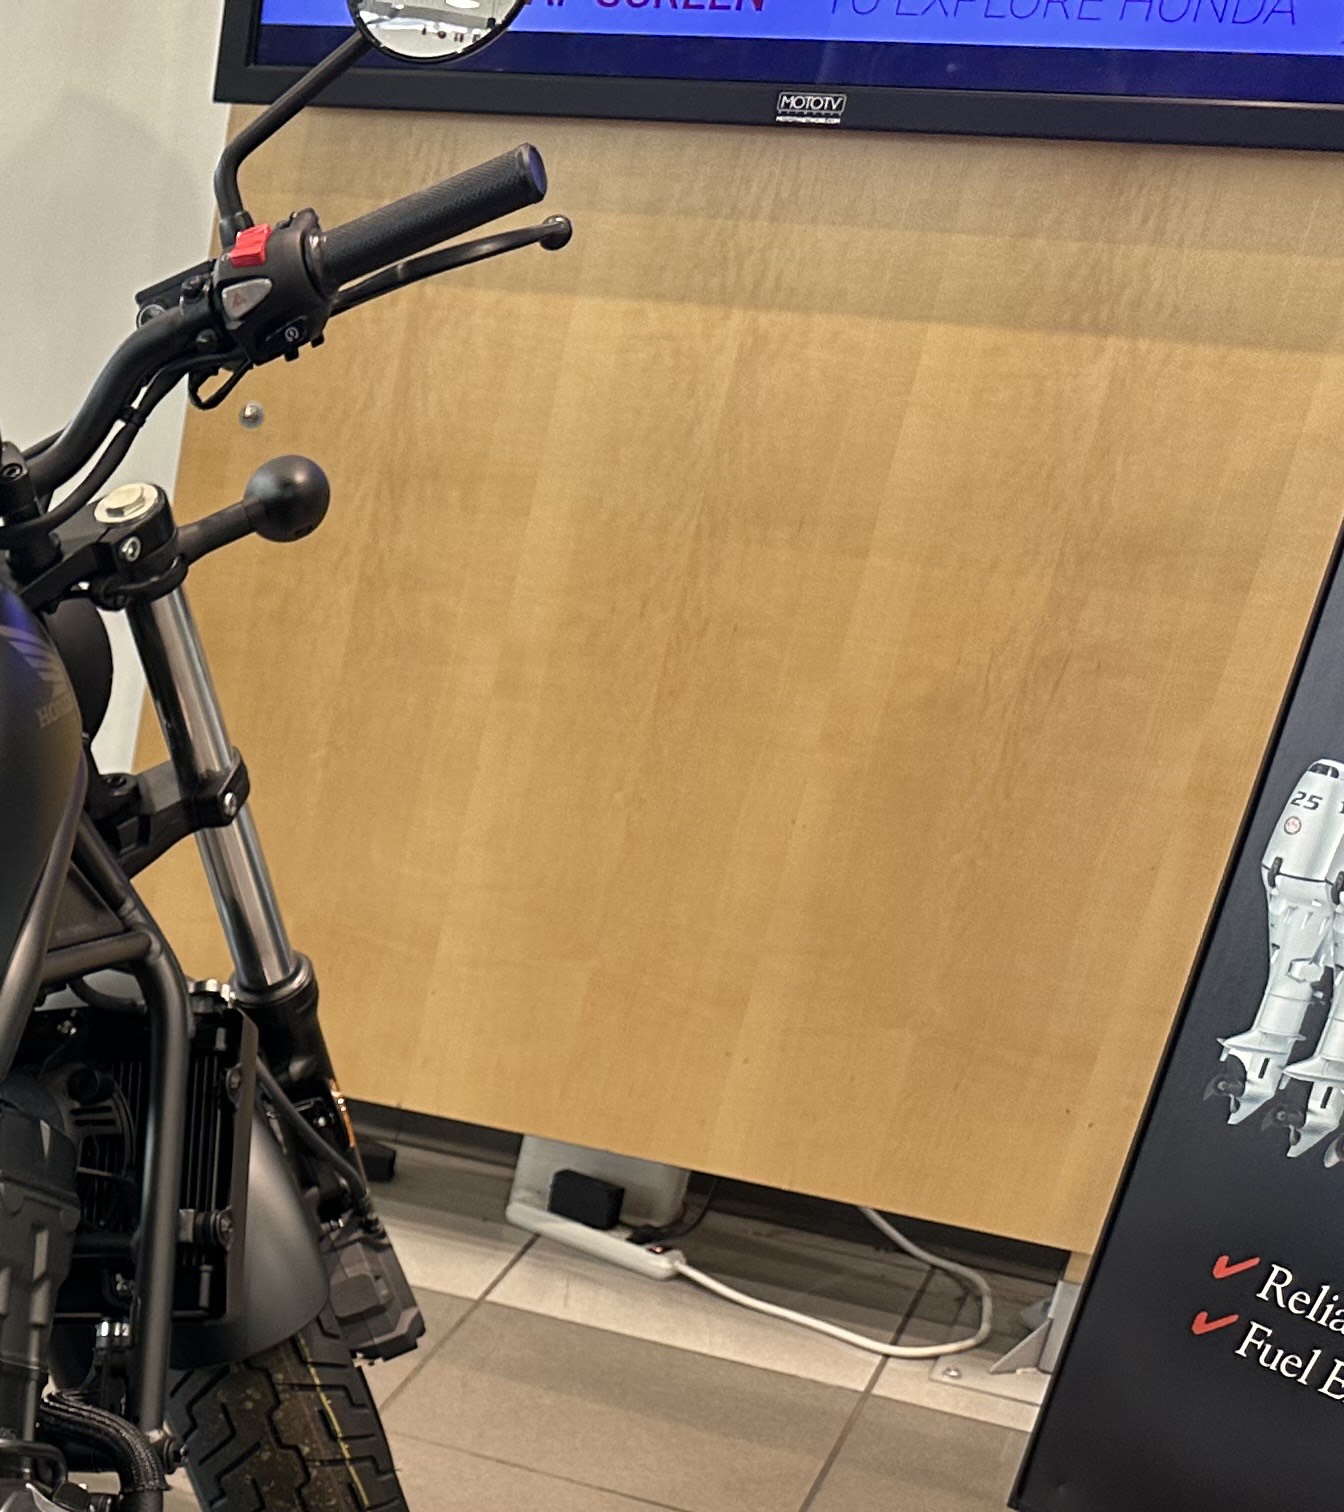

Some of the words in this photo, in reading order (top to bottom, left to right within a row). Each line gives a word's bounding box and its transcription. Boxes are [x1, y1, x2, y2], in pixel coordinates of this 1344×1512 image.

[781, 95, 843, 110] MOTOTV
[1290, 791, 1324, 811] 25
[1255, 1263, 1344, 1336] Relia
[1234, 1320, 1322, 1386] Fuel
